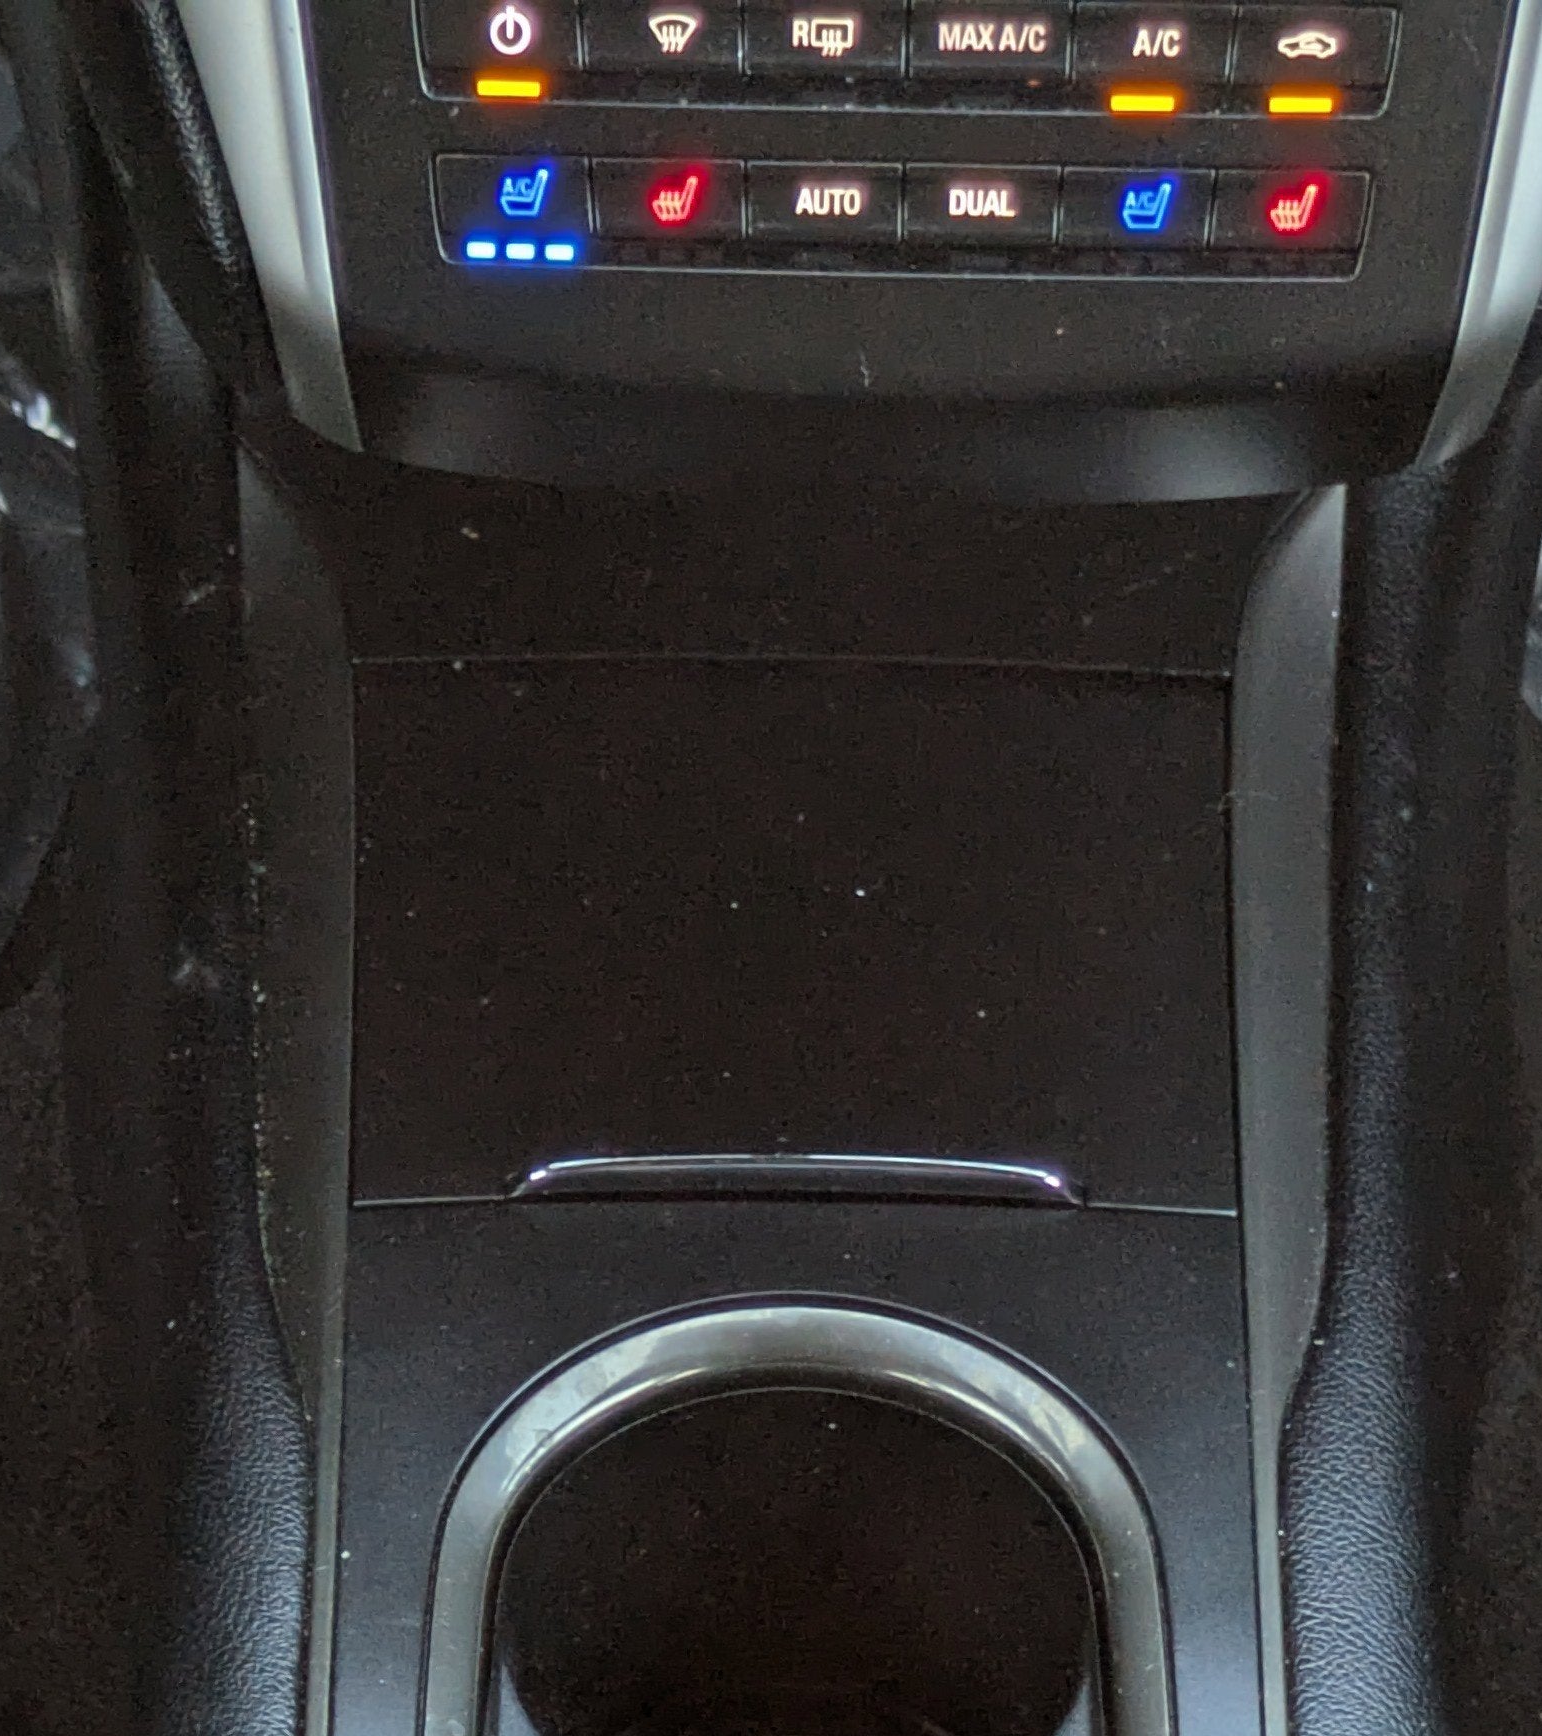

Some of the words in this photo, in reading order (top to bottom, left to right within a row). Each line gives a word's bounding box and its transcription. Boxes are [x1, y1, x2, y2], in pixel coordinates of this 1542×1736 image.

[938, 24, 994, 52] MAX
[999, 25, 1047, 53] A/C
[1132, 29, 1181, 58] A/C
[503, 176, 531, 196] A/C
[794, 189, 861, 216] AUTO
[948, 189, 1016, 217] DUAL
[1126, 191, 1153, 209] A/C
